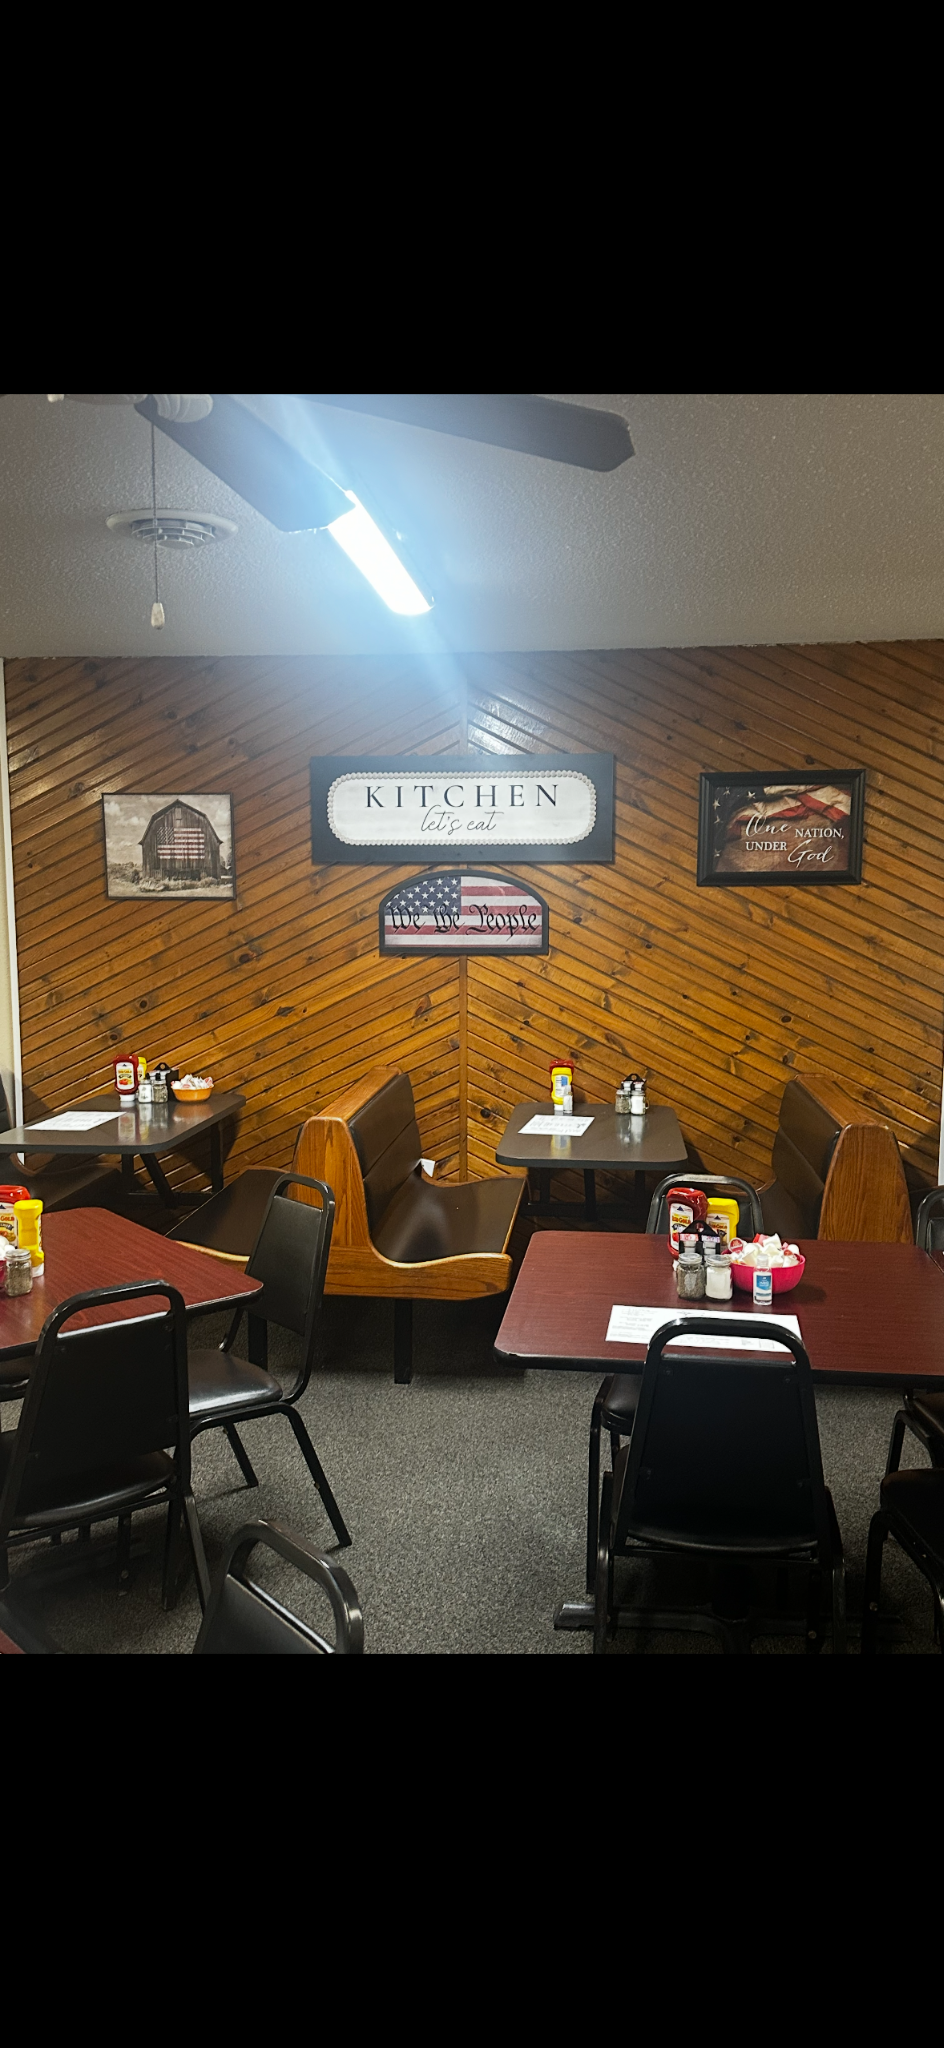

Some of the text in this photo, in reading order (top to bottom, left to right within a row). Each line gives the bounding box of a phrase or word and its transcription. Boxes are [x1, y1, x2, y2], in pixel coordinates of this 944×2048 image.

[365, 784, 558, 808] KITCHEN
[421, 804, 504, 836] let's eat
[745, 813, 844, 840] One NATION,
[745, 839, 834, 868] UNDER God
[387, 904, 426, 934] We
[466, 903, 540, 941] People
